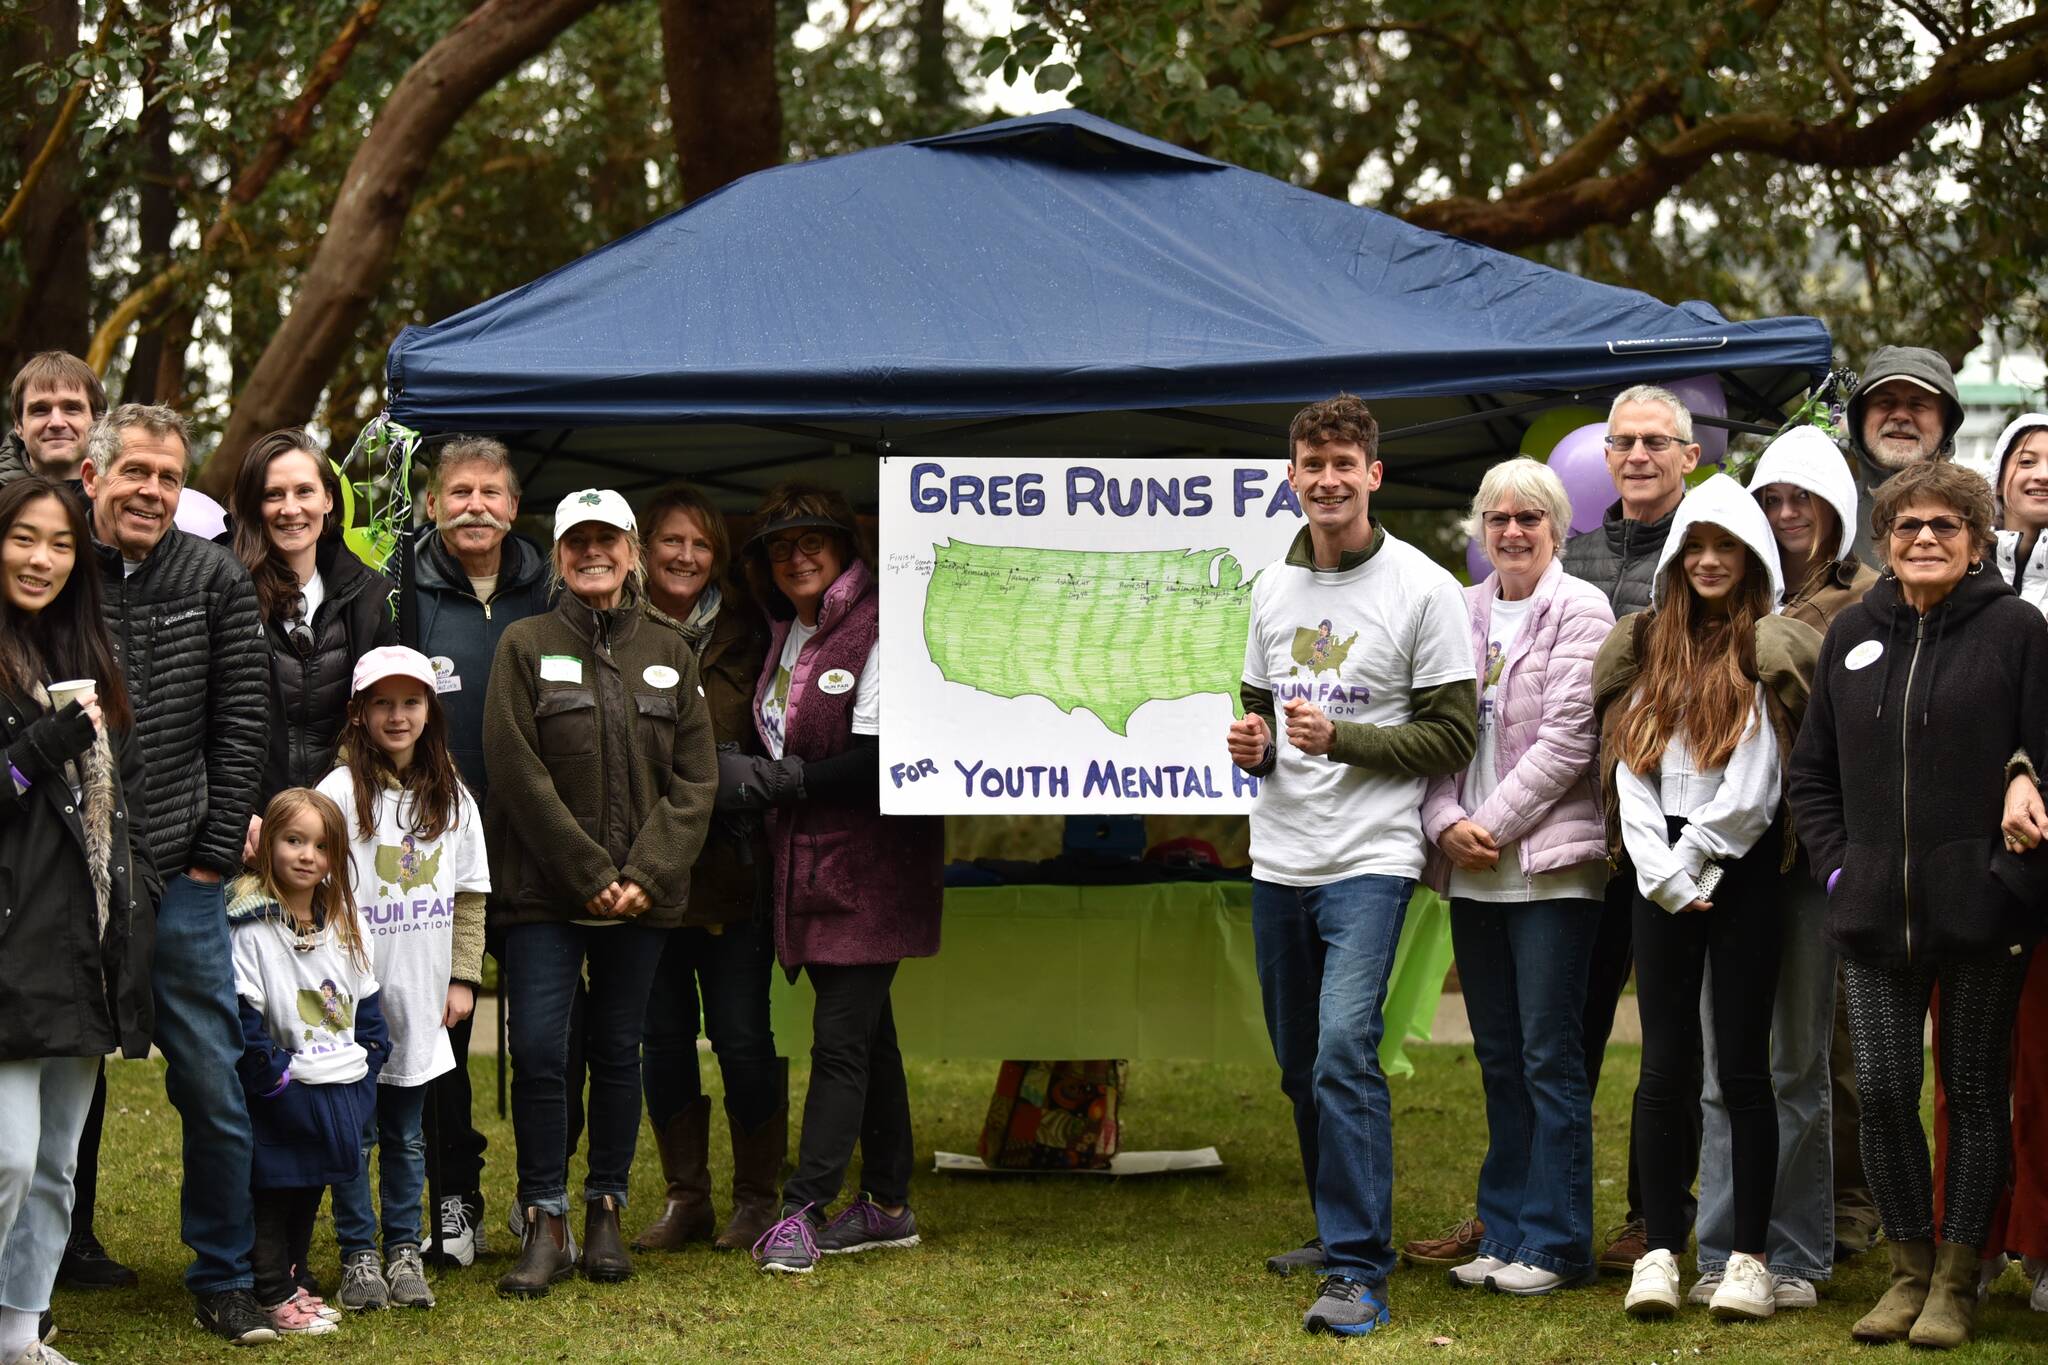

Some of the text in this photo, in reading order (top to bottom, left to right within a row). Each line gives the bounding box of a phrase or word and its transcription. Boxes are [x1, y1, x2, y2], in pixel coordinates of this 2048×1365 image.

[911, 463, 1303, 518] GREG RUNS FA
[889, 553, 916, 561] FINISH
[1271, 682, 1370, 705] RUN FAR
[890, 758, 939, 789] FOR
[954, 760, 1069, 798] YOUTH
[1083, 760, 1223, 798] MENTAL
[360, 901, 404, 926] RUN
